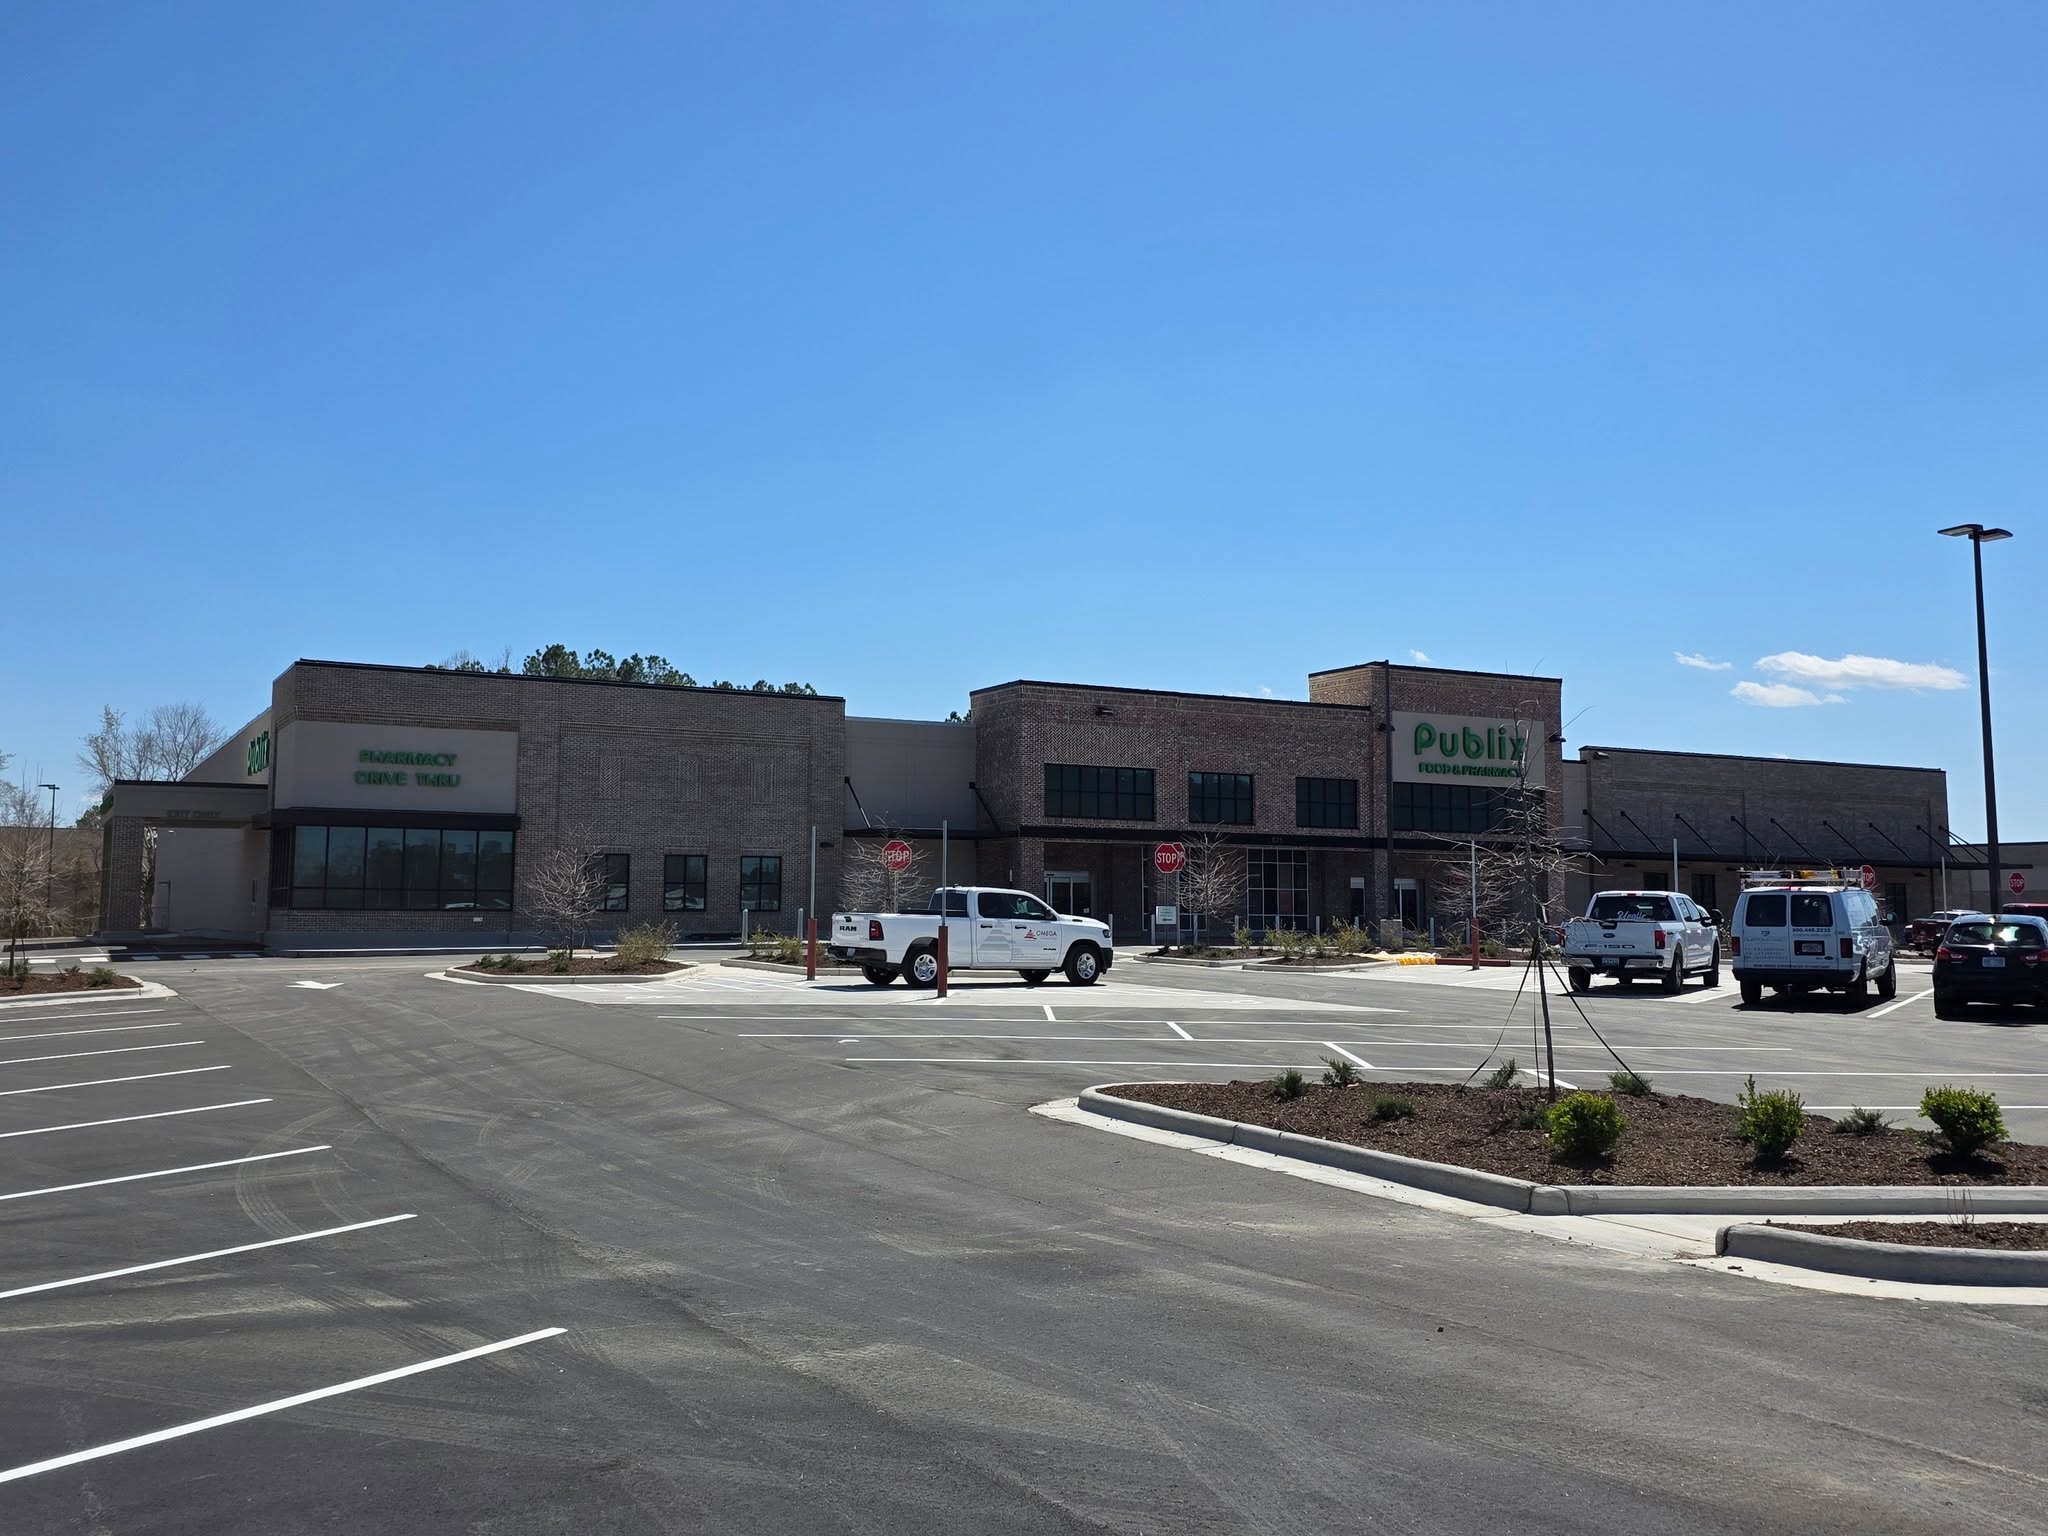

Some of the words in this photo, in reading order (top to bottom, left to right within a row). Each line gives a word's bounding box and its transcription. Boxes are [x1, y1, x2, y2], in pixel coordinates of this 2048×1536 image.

[1414, 722, 1526, 760] Publix
[359, 749, 458, 767] PHARMACY
[354, 770, 408, 785] DRIVE
[415, 771, 461, 787] THRU
[1156, 852, 1177, 864] STOP
[2010, 878, 2024, 887] STOP
